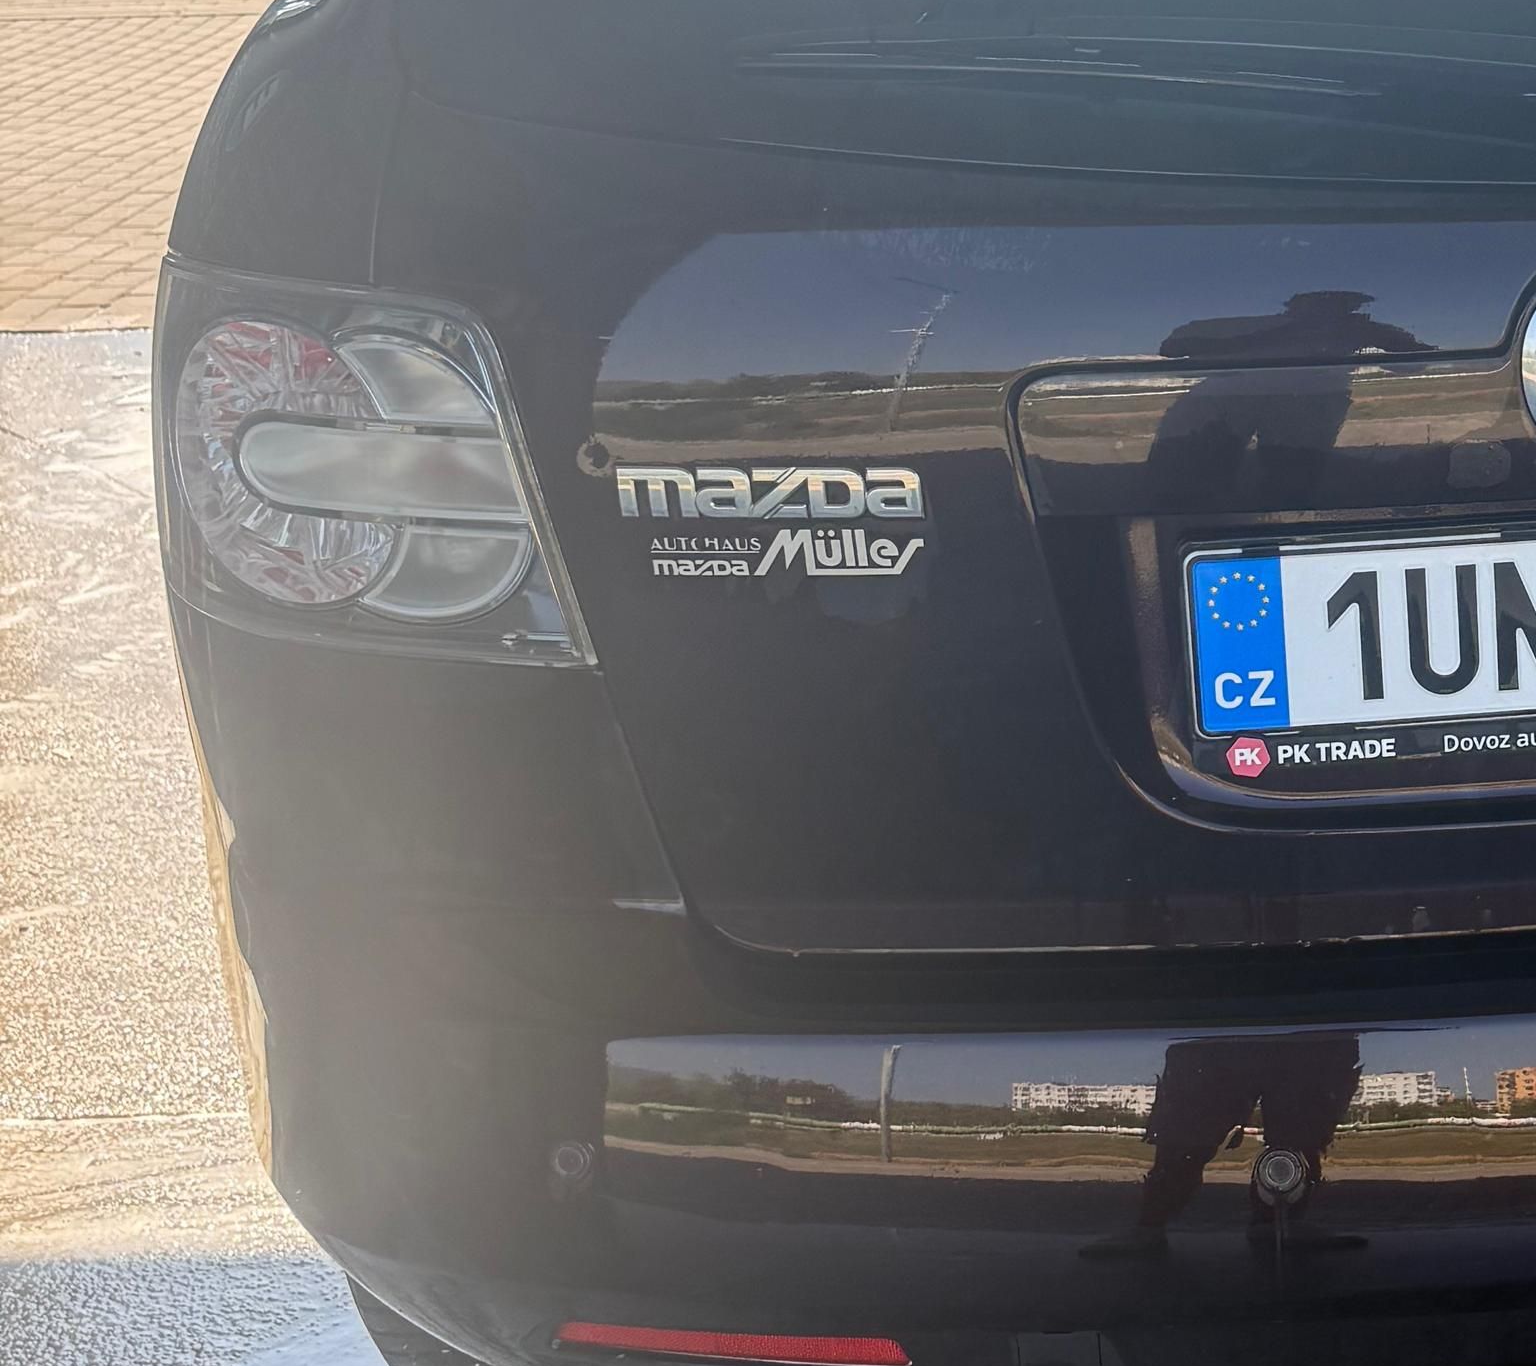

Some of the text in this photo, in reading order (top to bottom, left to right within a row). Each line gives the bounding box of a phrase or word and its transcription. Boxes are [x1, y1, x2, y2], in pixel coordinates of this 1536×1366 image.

[1214, 669, 1277, 712] CZ
[1276, 737, 1397, 765] PK TRADE
[1443, 733, 1512, 754] Dovoz
